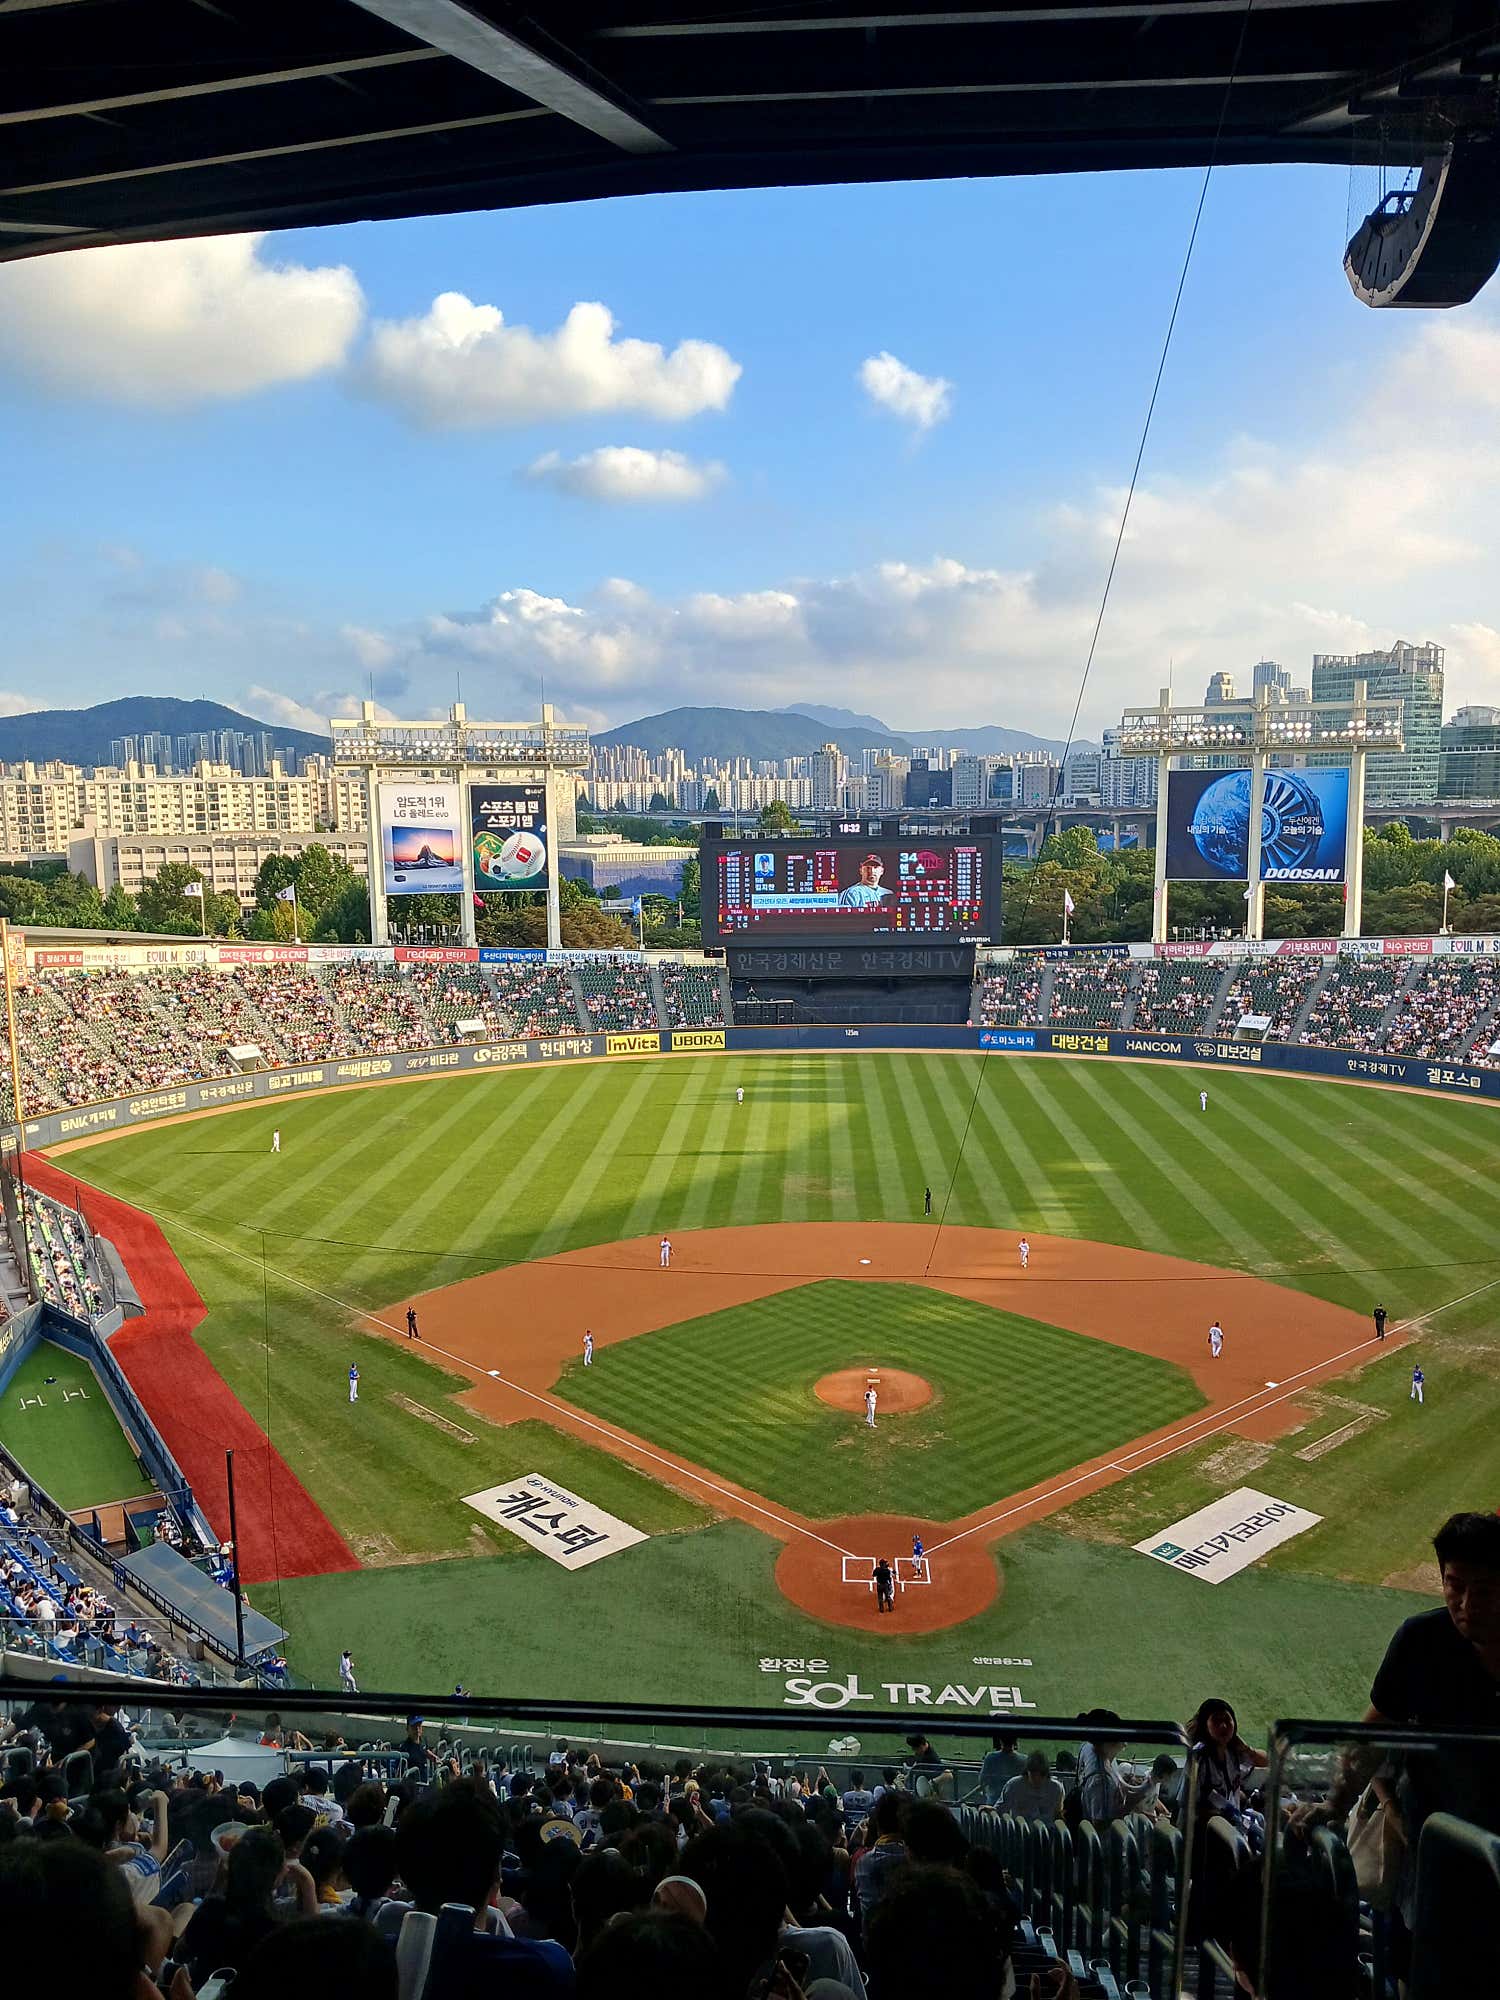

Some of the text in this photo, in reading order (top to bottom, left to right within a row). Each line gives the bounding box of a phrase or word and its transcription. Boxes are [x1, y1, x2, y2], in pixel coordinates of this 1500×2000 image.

[396, 796, 445, 808] 압도적 1위
[479, 800, 514, 813] 스포츠
[393, 809, 407, 818] LG
[409, 808, 435, 818] 올레드
[1288, 815, 1320, 826] 두산에겐
[486, 815, 534, 828] 스포키 앱
[1281, 825, 1306, 835] 오늘의
[900, 852, 918, 862] 34
[1264, 868, 1341, 880] DOOSAN
[953, 912, 979, 920] 1 2 0
[1286, 941, 1331, 952] 기부&RUN
[1385, 941, 1402, 950] 익수
[219, 950, 263, 962] DX전문기업
[275, 951, 288, 959] LG
[288, 951, 307, 959] CNS
[405, 949, 444, 961] redcap
[736, 952, 842, 971] 한국경제신문
[539, 1038, 593, 1057] 현대해상
[673, 1033, 724, 1048] UBORA
[1051, 1033, 1109, 1052] 대방건설
[1126, 1039, 1182, 1054] HANCOM
[491, 1043, 528, 1062] 금강주택
[1216, 1043, 1262, 1061] 대보건설
[1347, 1059, 1406, 1077] 한국경제TV
[1426, 1067, 1470, 1087] 겔포스
[199, 1080, 254, 1100] 한국경제신문
[140, 1091, 187, 1110] 유안타증권
[540, 1485, 579, 1508] HYUNDAI
[496, 1490, 610, 1555] 캐스퍼
[1173, 1502, 1297, 1570] 메디카코리아
[758, 1657, 830, 1674] 환전은
[783, 1674, 1037, 1710] SOL TRAVEL
